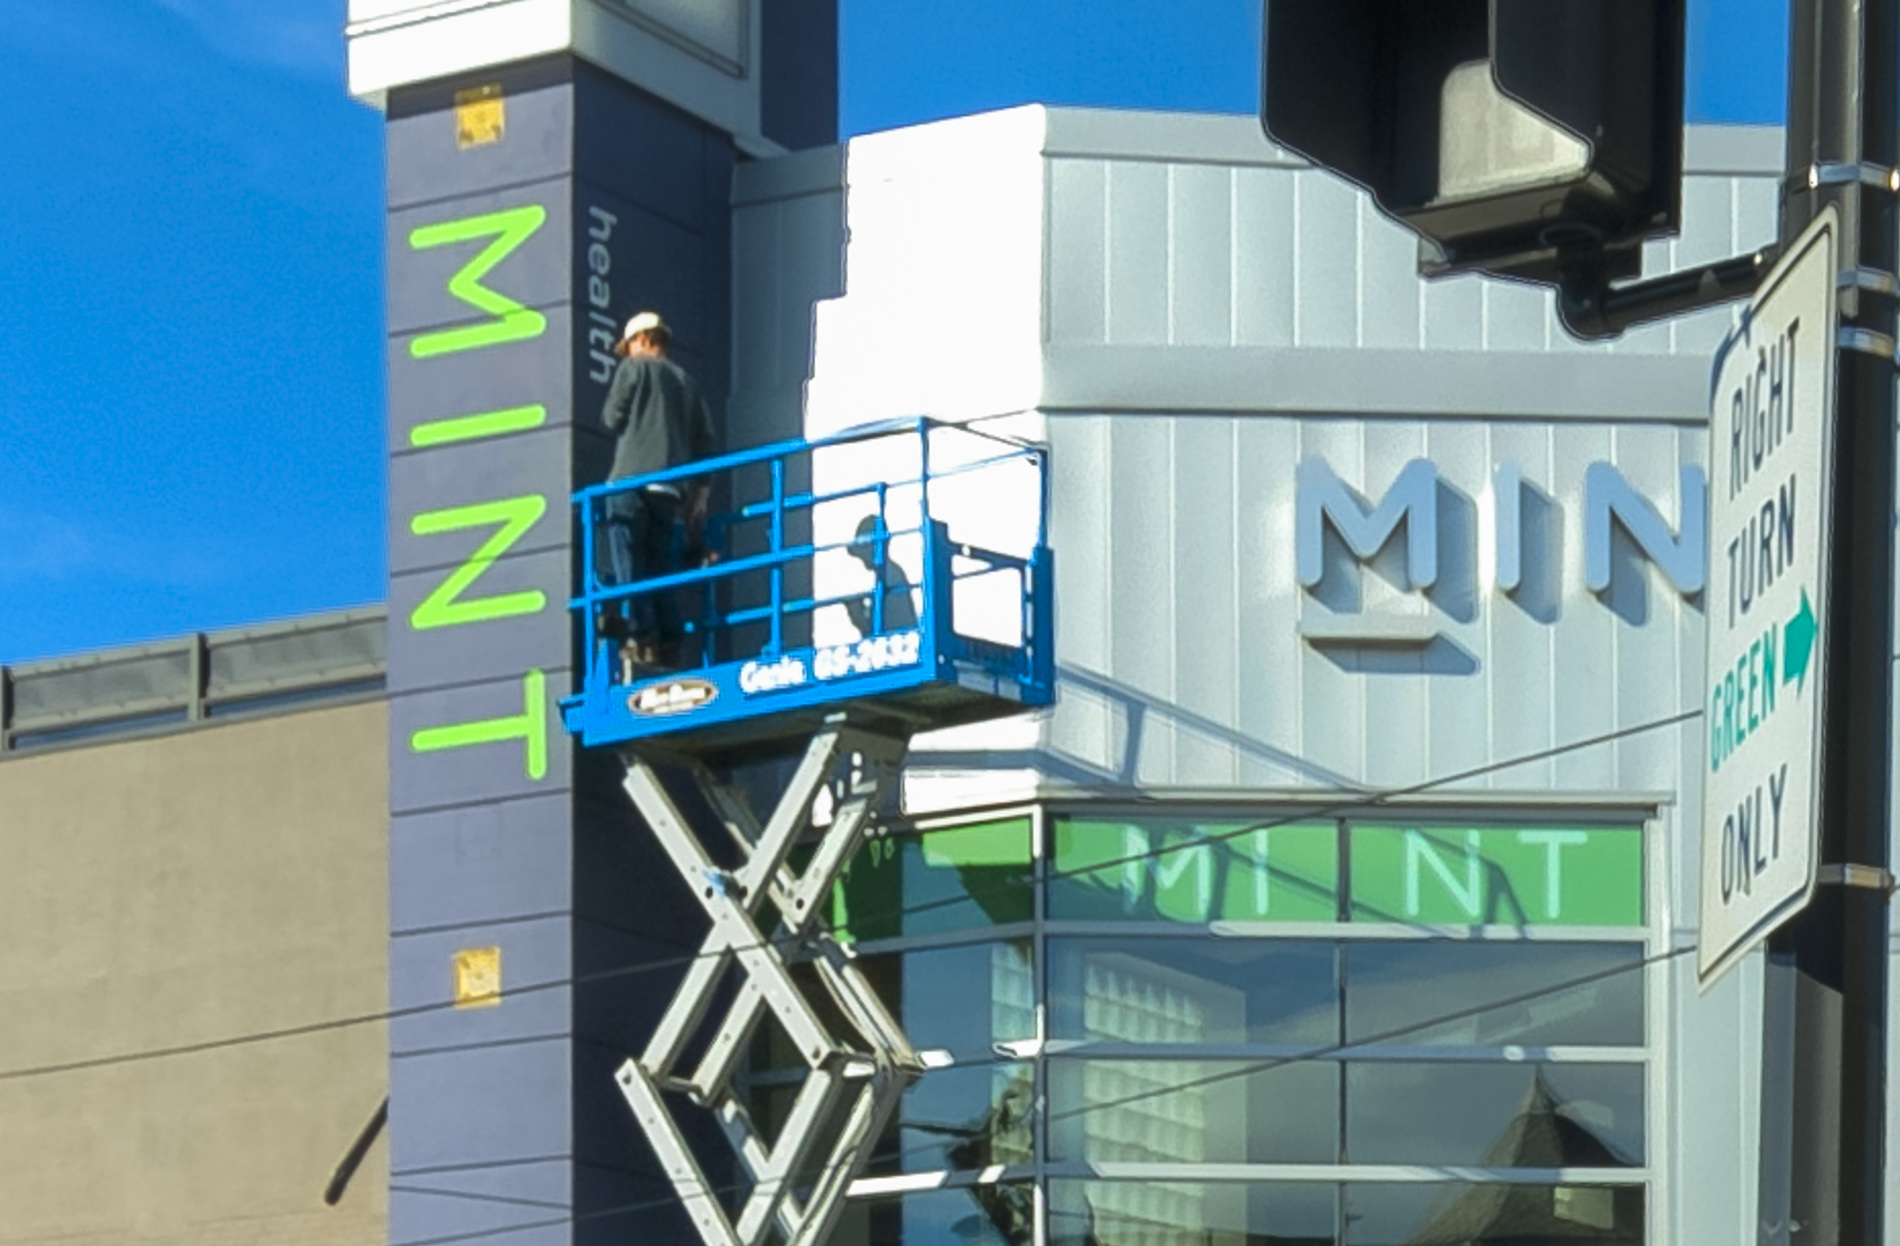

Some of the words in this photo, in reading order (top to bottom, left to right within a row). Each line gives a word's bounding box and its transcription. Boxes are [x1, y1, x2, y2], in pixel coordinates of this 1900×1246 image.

[587, 204, 618, 385] health
[1728, 317, 1799, 502] RIGHT
[407, 204, 547, 781] MINT
[1298, 455, 1705, 594] MIN
[1726, 473, 1797, 630] TURN
[1710, 620, 1778, 773] GREEN
[1122, 826, 1588, 919] MINT
[1720, 762, 1788, 906] ONLY
